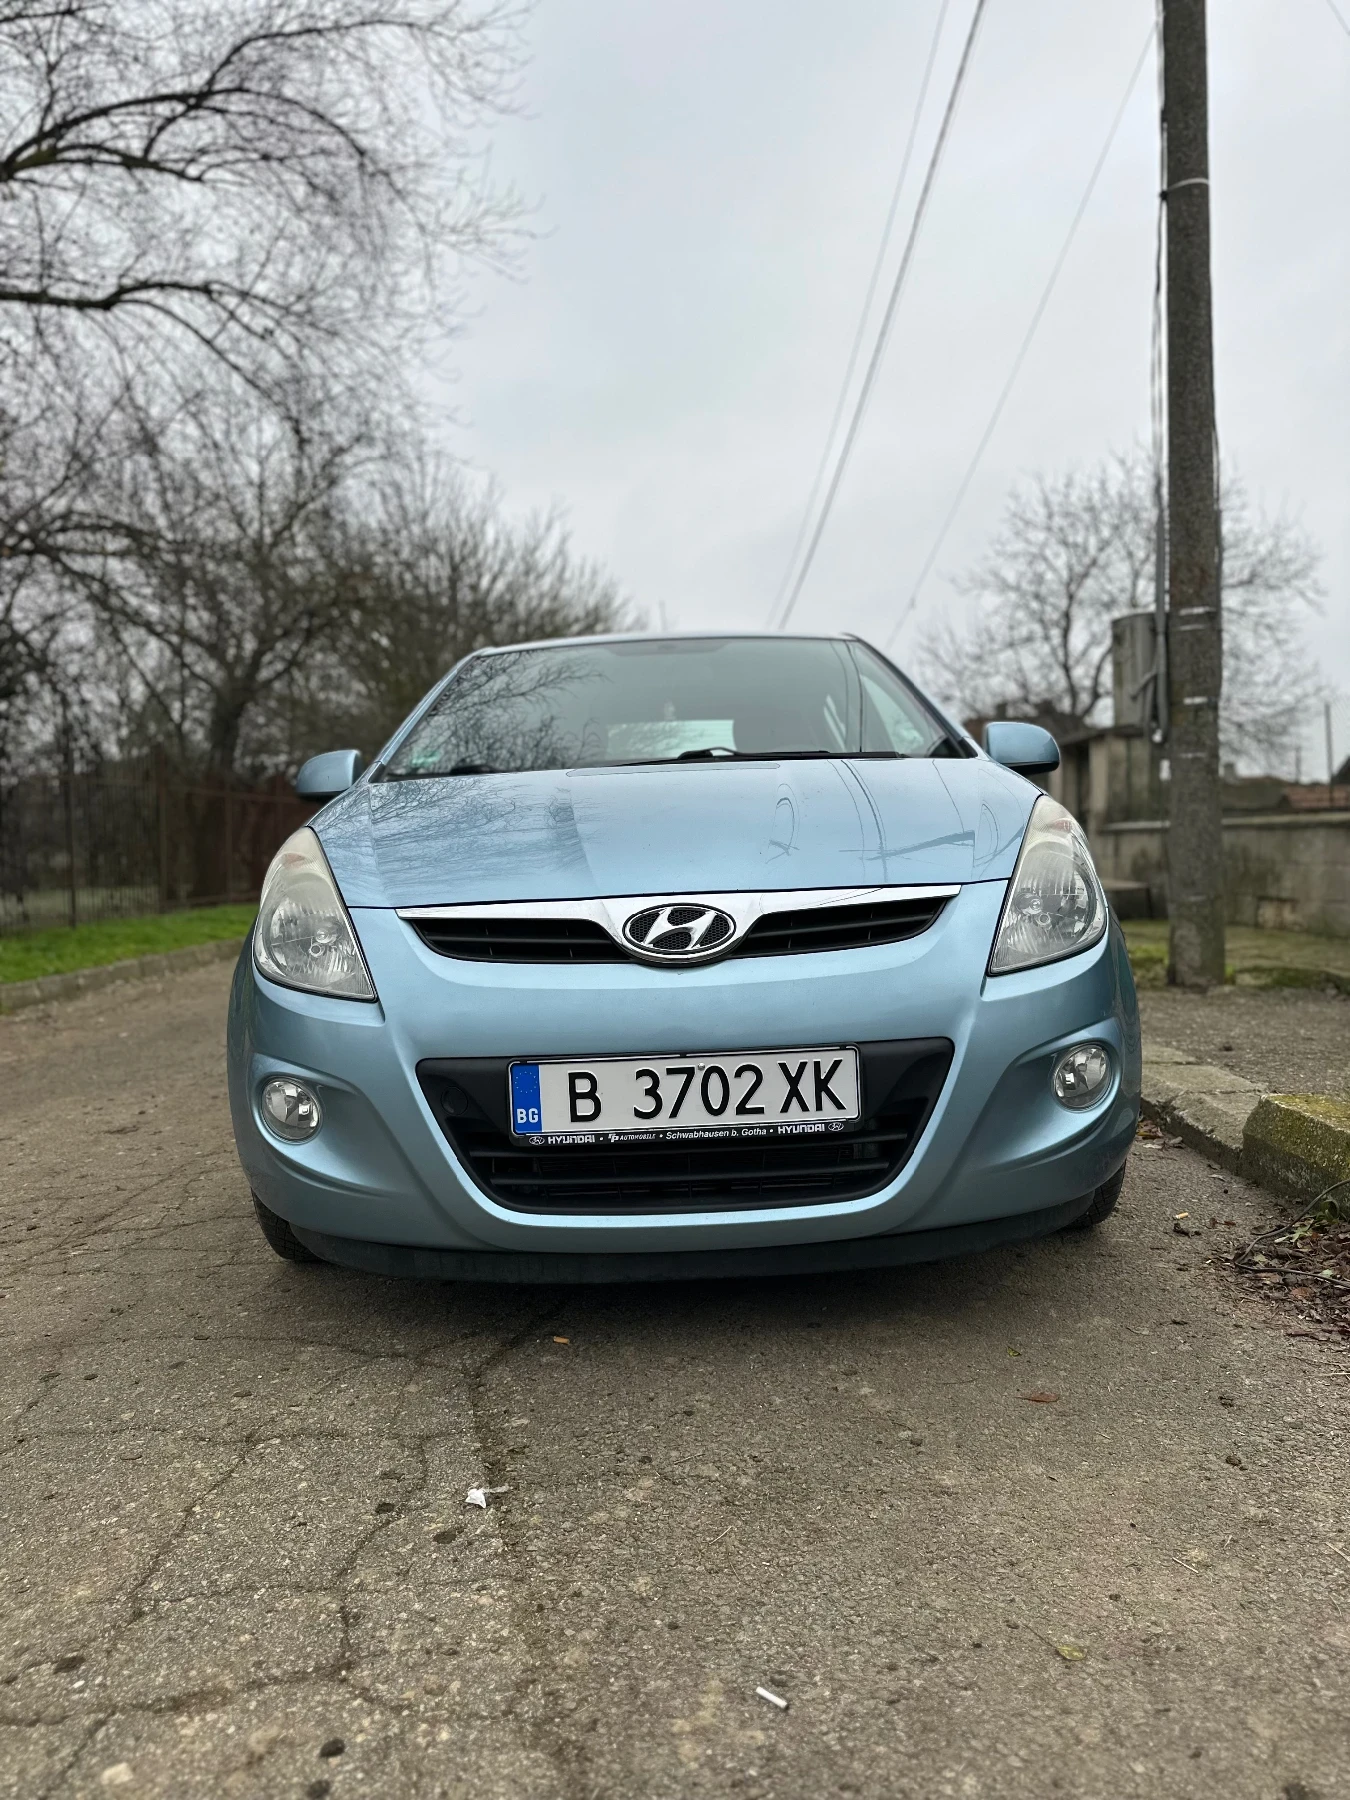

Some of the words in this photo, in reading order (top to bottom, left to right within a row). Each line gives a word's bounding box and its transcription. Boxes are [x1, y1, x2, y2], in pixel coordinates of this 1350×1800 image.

[568, 1071, 602, 1123] B
[633, 1063, 765, 1120] 3702
[777, 1058, 848, 1114] XK
[517, 1107, 539, 1125] BG
[547, 1134, 596, 1145] HYUNDAI
[665, 1129, 729, 1140] Schwabhausen
[731, 1128, 739, 1137] b.
[741, 1127, 767, 1137] Gotha
[777, 1123, 826, 1135] HYUNDAI
